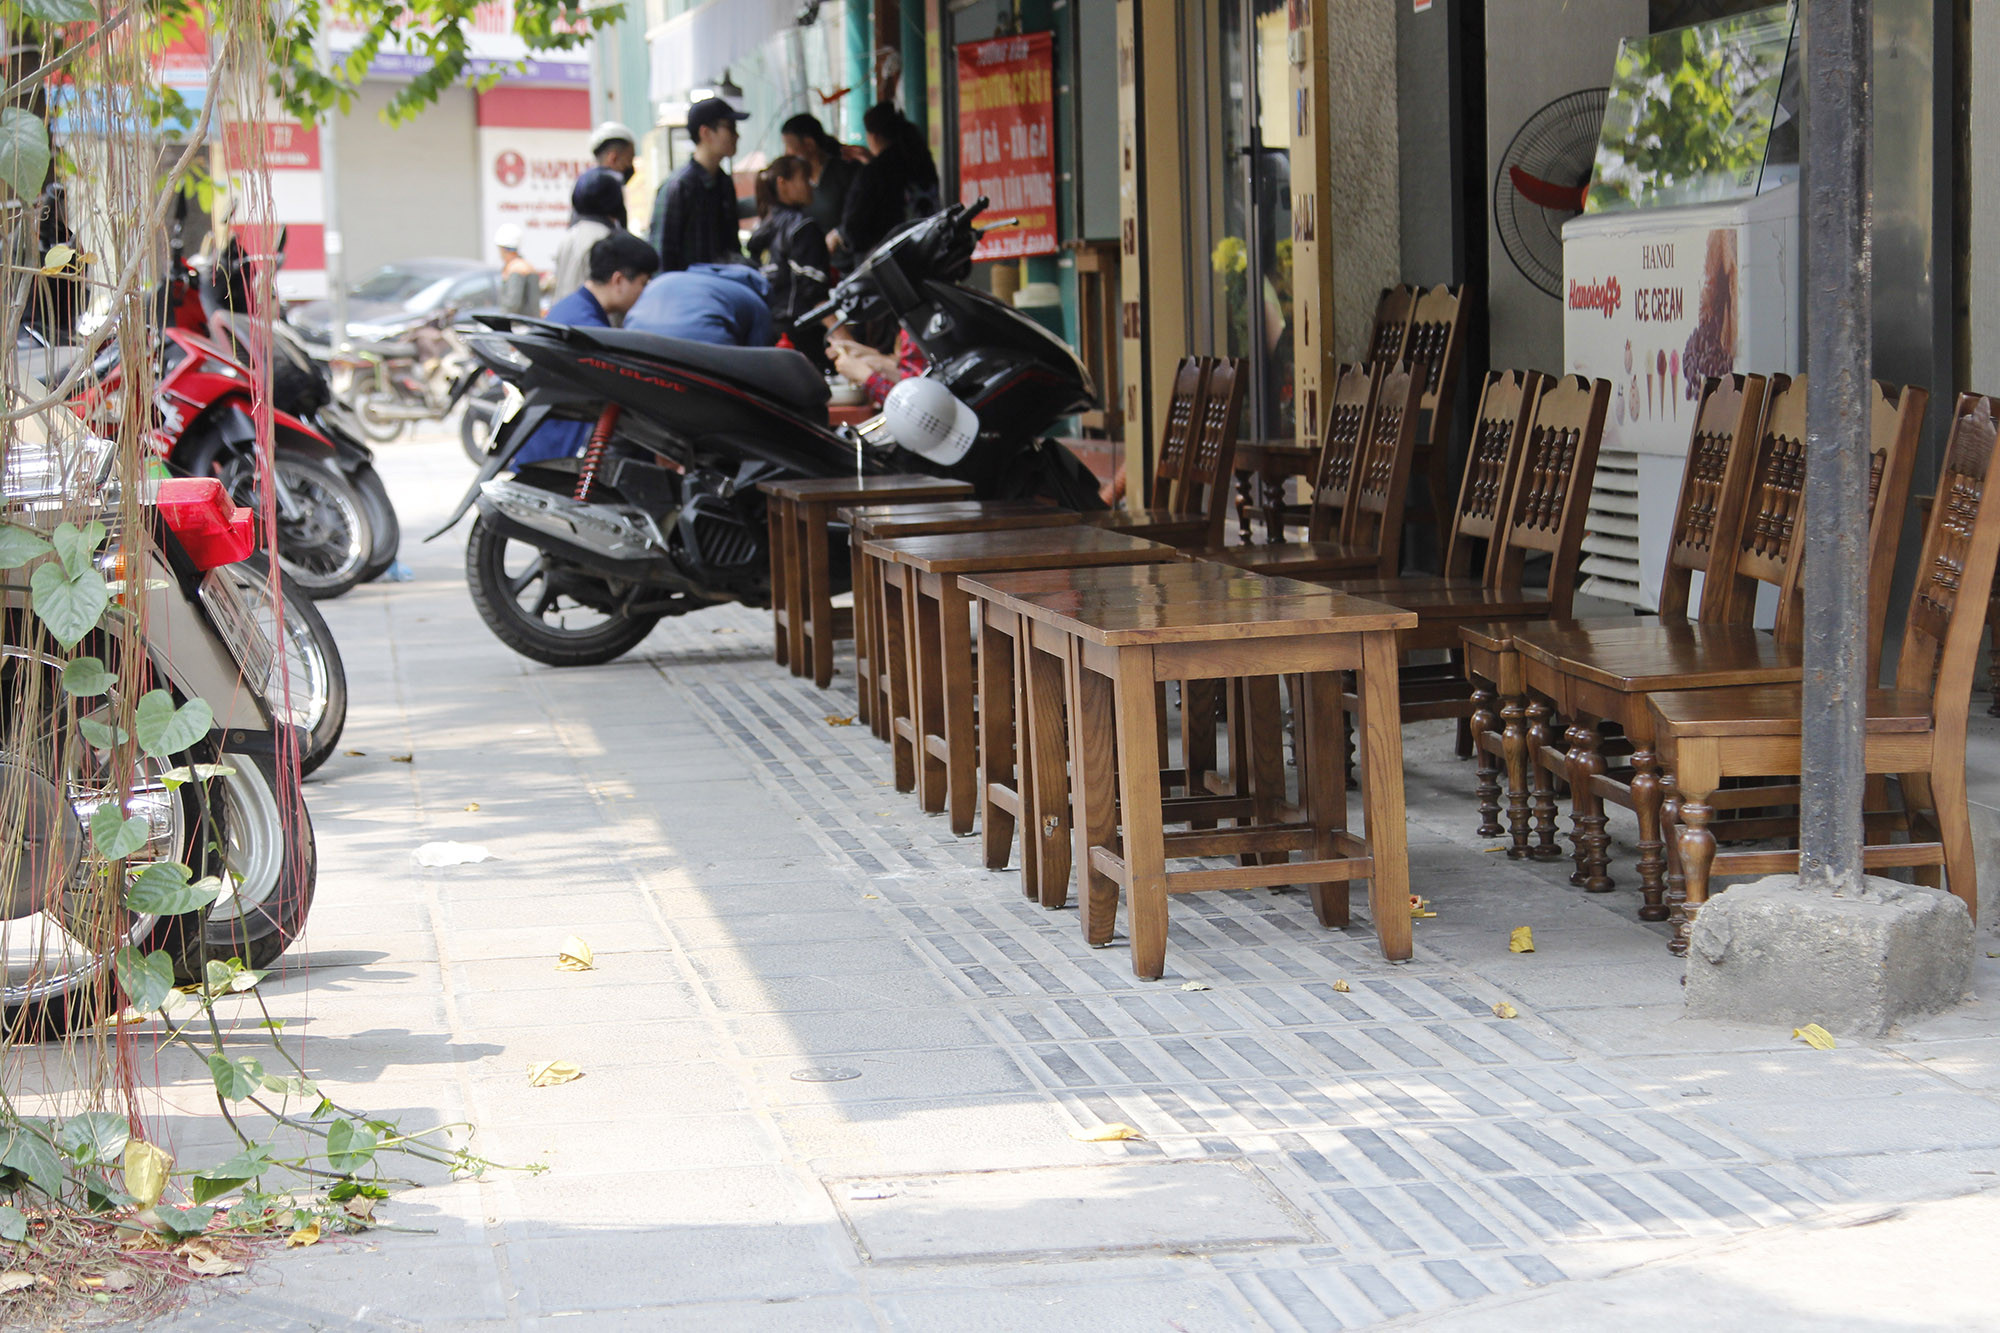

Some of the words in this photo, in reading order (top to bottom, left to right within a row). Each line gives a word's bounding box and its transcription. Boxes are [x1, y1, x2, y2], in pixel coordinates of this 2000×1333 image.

[1642, 243, 1675, 270] HANOI
[1634, 286, 1650, 321] ICE
[1651, 286, 1683, 323] CREAM
